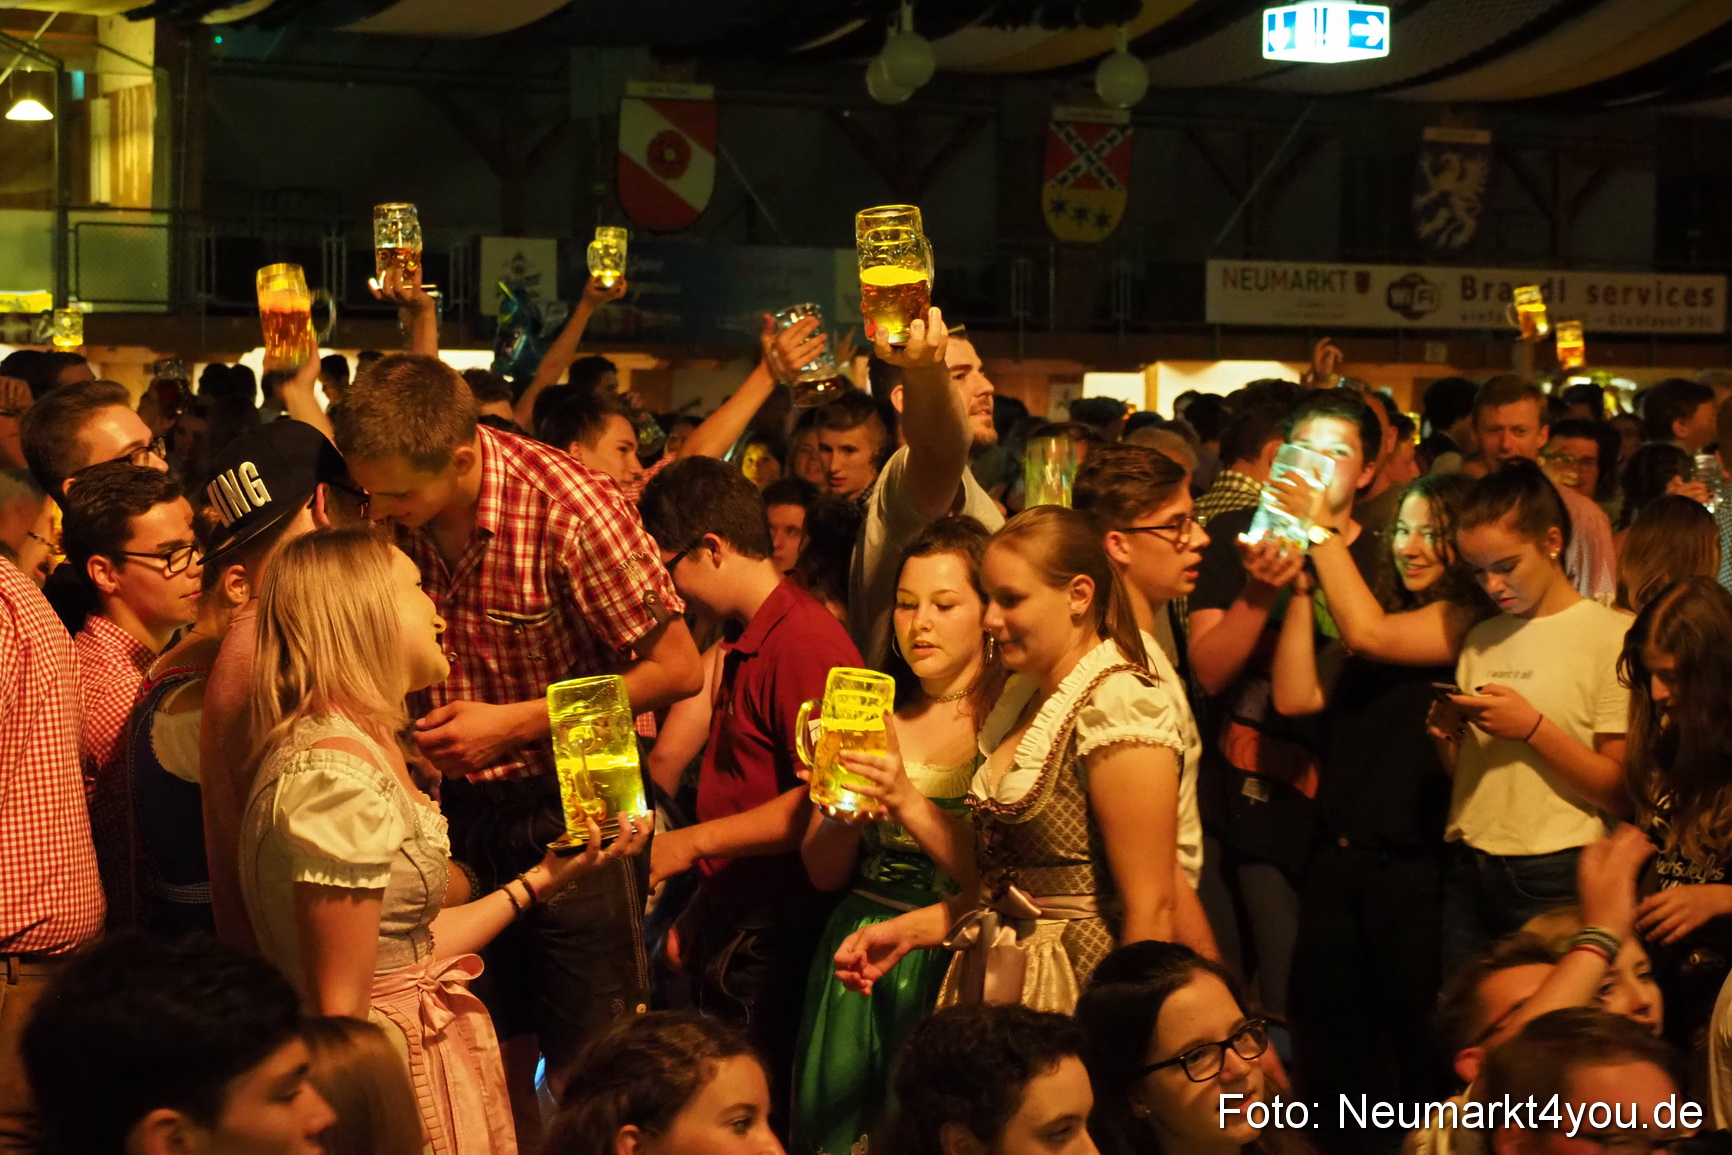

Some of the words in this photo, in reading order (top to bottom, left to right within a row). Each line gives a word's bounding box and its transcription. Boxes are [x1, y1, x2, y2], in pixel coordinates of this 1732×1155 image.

[1221, 267, 1348, 292] NEUMARKT
[1461, 275, 1565, 303] Bradl
[1587, 281, 1714, 306] services
